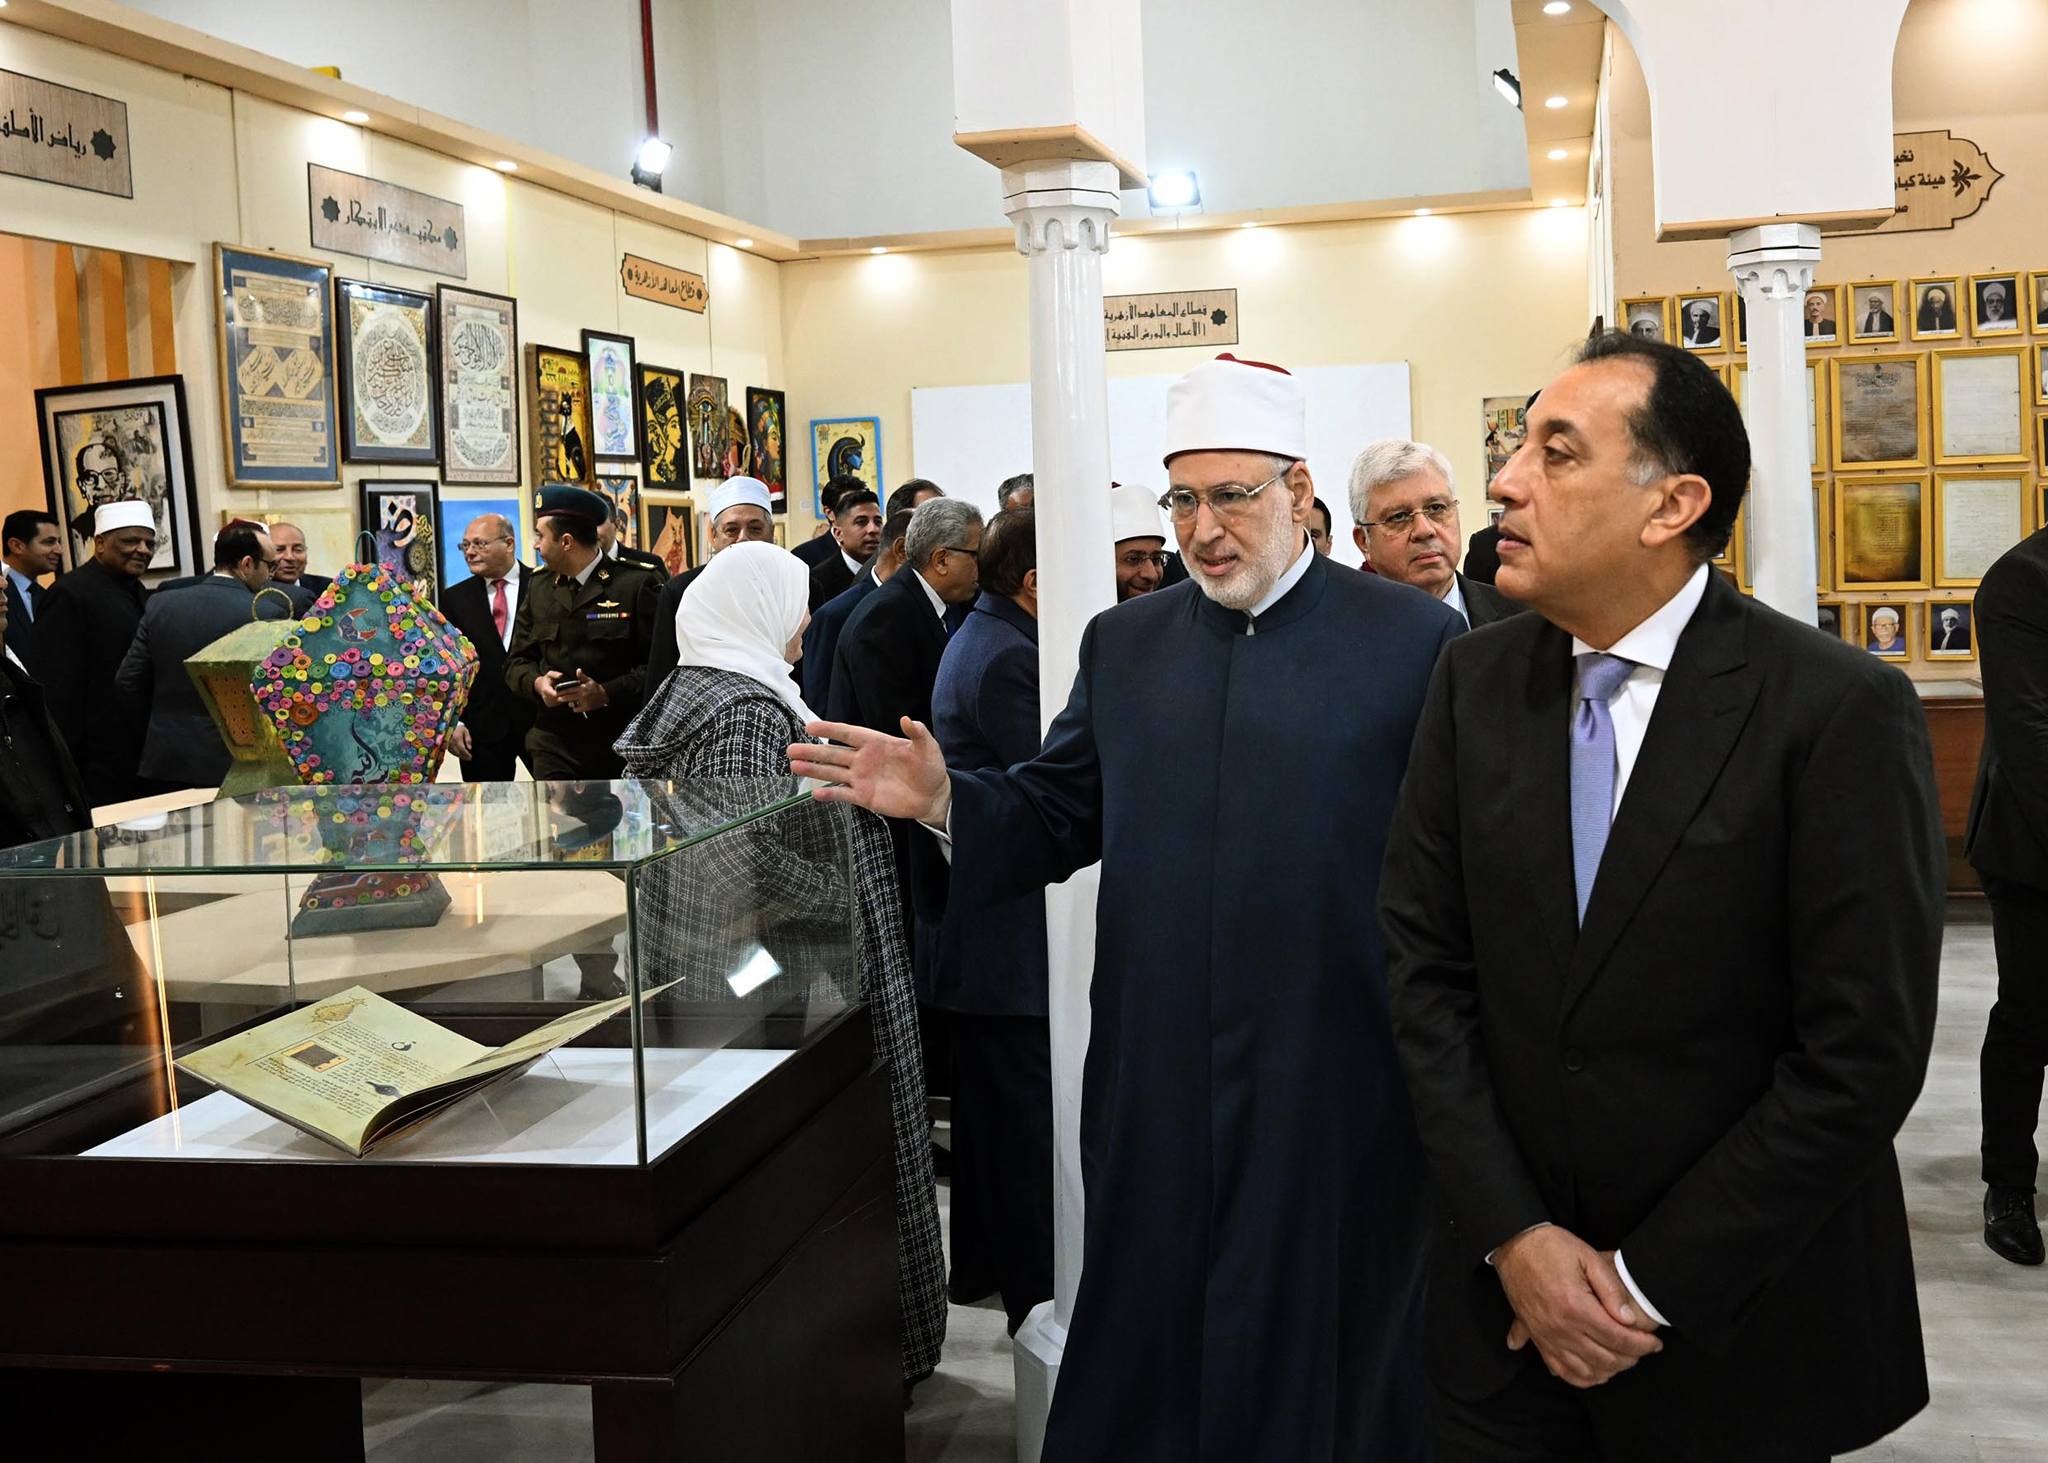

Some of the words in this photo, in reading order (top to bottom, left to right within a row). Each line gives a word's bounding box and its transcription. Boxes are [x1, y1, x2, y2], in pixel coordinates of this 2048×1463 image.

[0, 107, 44, 144] الأطف
[47, 122, 87, 159] رياض
[1894, 149, 1914, 167] نخب
[1918, 172, 1946, 189] هيئة
[1137, 301, 1179, 319] المعاهد
[1179, 301, 1208, 318] قطاع
